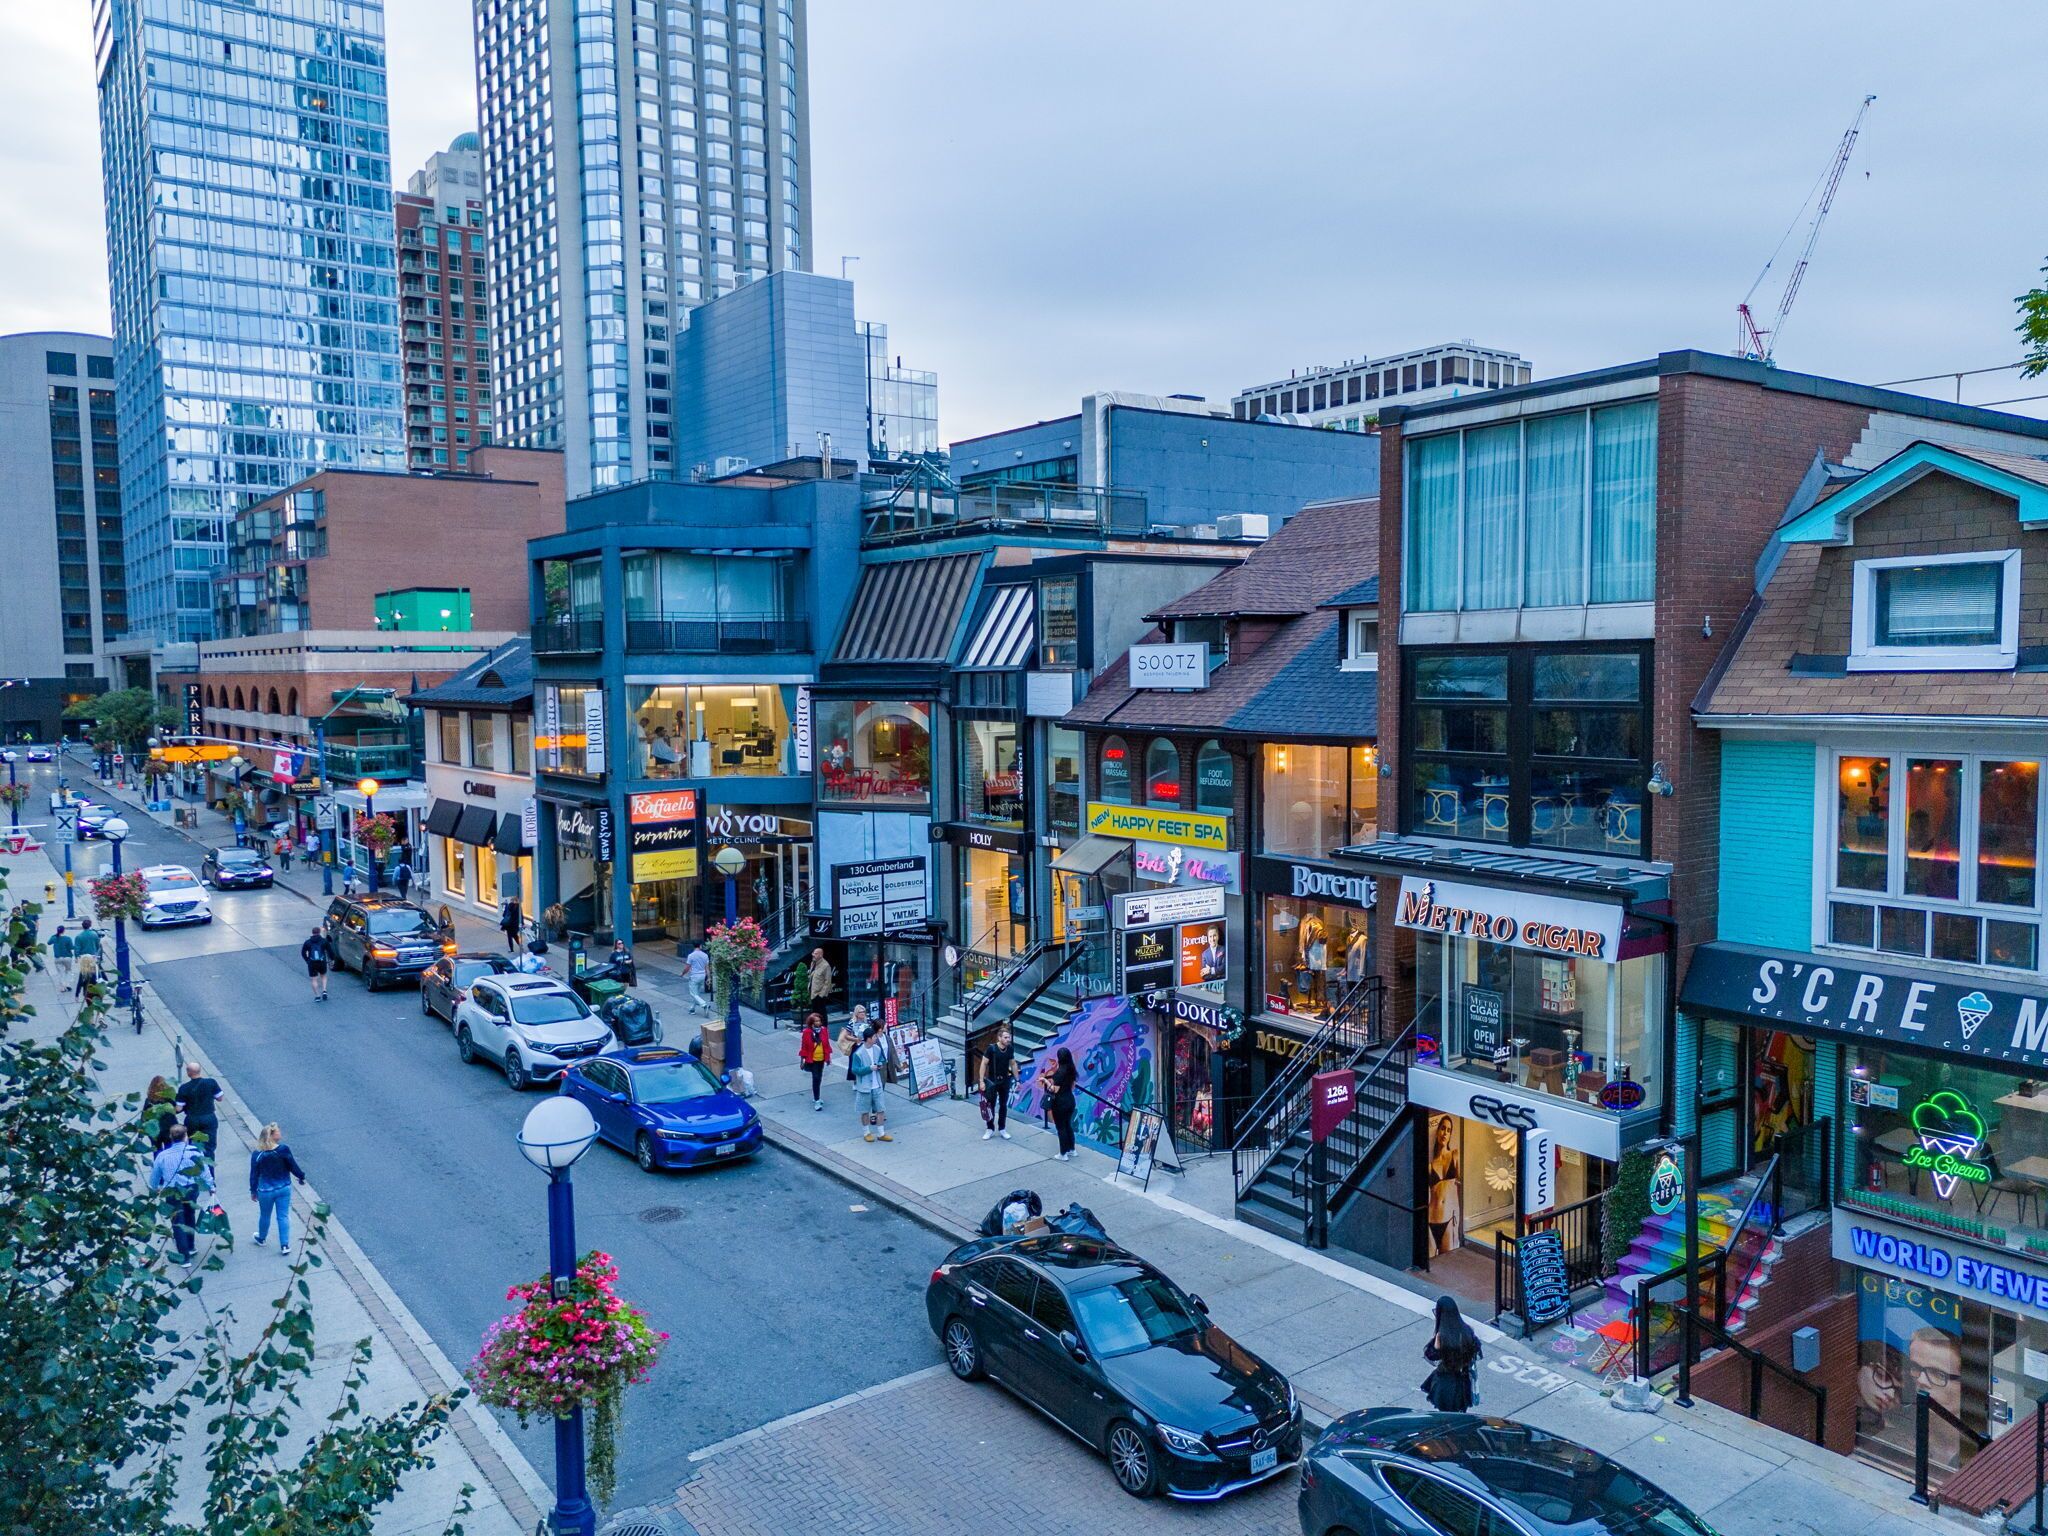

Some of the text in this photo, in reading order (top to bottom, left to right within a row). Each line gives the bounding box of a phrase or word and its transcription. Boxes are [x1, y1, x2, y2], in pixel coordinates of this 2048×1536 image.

[1138, 654, 1196, 670] SOOTZ
[190, 685, 201, 735] PARK
[1105, 769, 1128, 778] MASSAGE
[1207, 769, 1224, 778] FOOT
[1199, 777, 1232, 787] REFLEXOLOGY
[632, 796, 694, 818] Raffaello
[601, 811, 609, 831] YOU
[735, 815, 778, 833] YOU
[1091, 809, 1110, 829] NEW
[1112, 814, 1154, 832] HAPPY
[1157, 819, 1191, 837] FEET
[1194, 824, 1224, 841] SPA
[970, 832, 993, 846] HOLLY
[602, 839, 610, 861] NEW
[850, 860, 914, 876] 130 Cumberland
[842, 881, 880, 896] bespoke
[884, 879, 924, 889] GOLDSTRUCK
[1129, 903, 1147, 911] LEGACY
[843, 910, 878, 924] HOLLY
[1401, 890, 1602, 957] METRO CIGAR
[843, 921, 878, 932] EYEWEAR
[1135, 945, 1164, 956] MUZEUM
[1269, 999, 1286, 1012] Sale
[1470, 995, 1499, 1008] METRO
[1470, 1004, 1499, 1018] CIGAR
[1488, 1017, 1499, 1025] SHOP
[1747, 1005, 1782, 1017] ICE
[1806, 1015, 1884, 1035] CREAM
[1474, 1028, 1495, 1045] OPEN
[1327, 1085, 1349, 1099] 126A
[1602, 1087, 1640, 1103] OPEN
[1537, 1138, 1548, 1205] ERES
[1903, 1146, 1988, 1181] Ice Cream
[1850, 1227, 1949, 1278] WORLD
[1862, 1274, 1960, 1320] GUCCI
